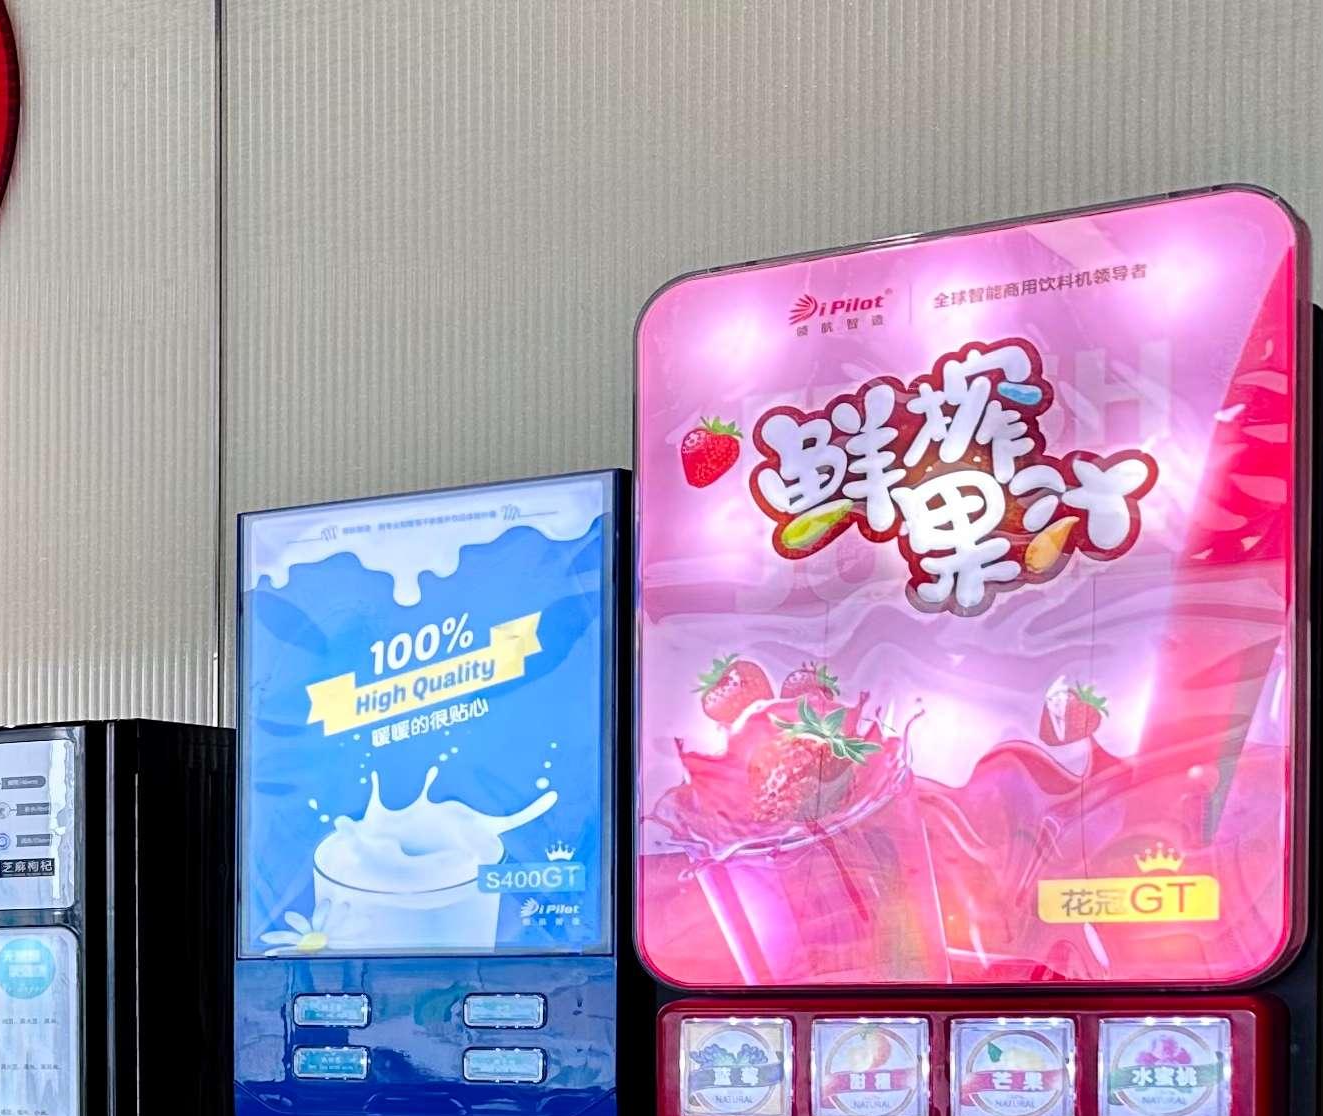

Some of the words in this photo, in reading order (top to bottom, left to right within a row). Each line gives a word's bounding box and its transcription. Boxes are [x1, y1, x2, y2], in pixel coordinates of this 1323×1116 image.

[933, 263, 1148, 310] 全球智能商用饮料机领导者
[370, 612, 475, 676] 100%
[355, 685, 407, 717] High
[412, 658, 496, 700] Quality
[371, 696, 490, 748] 暖暖的很贴心
[486, 864, 581, 889] S400GT
[1059, 880, 1198, 918] 花冠GT
[992, 1071, 1044, 1091] 芒果
[1132, 1066, 1198, 1088] 水蜜桃
